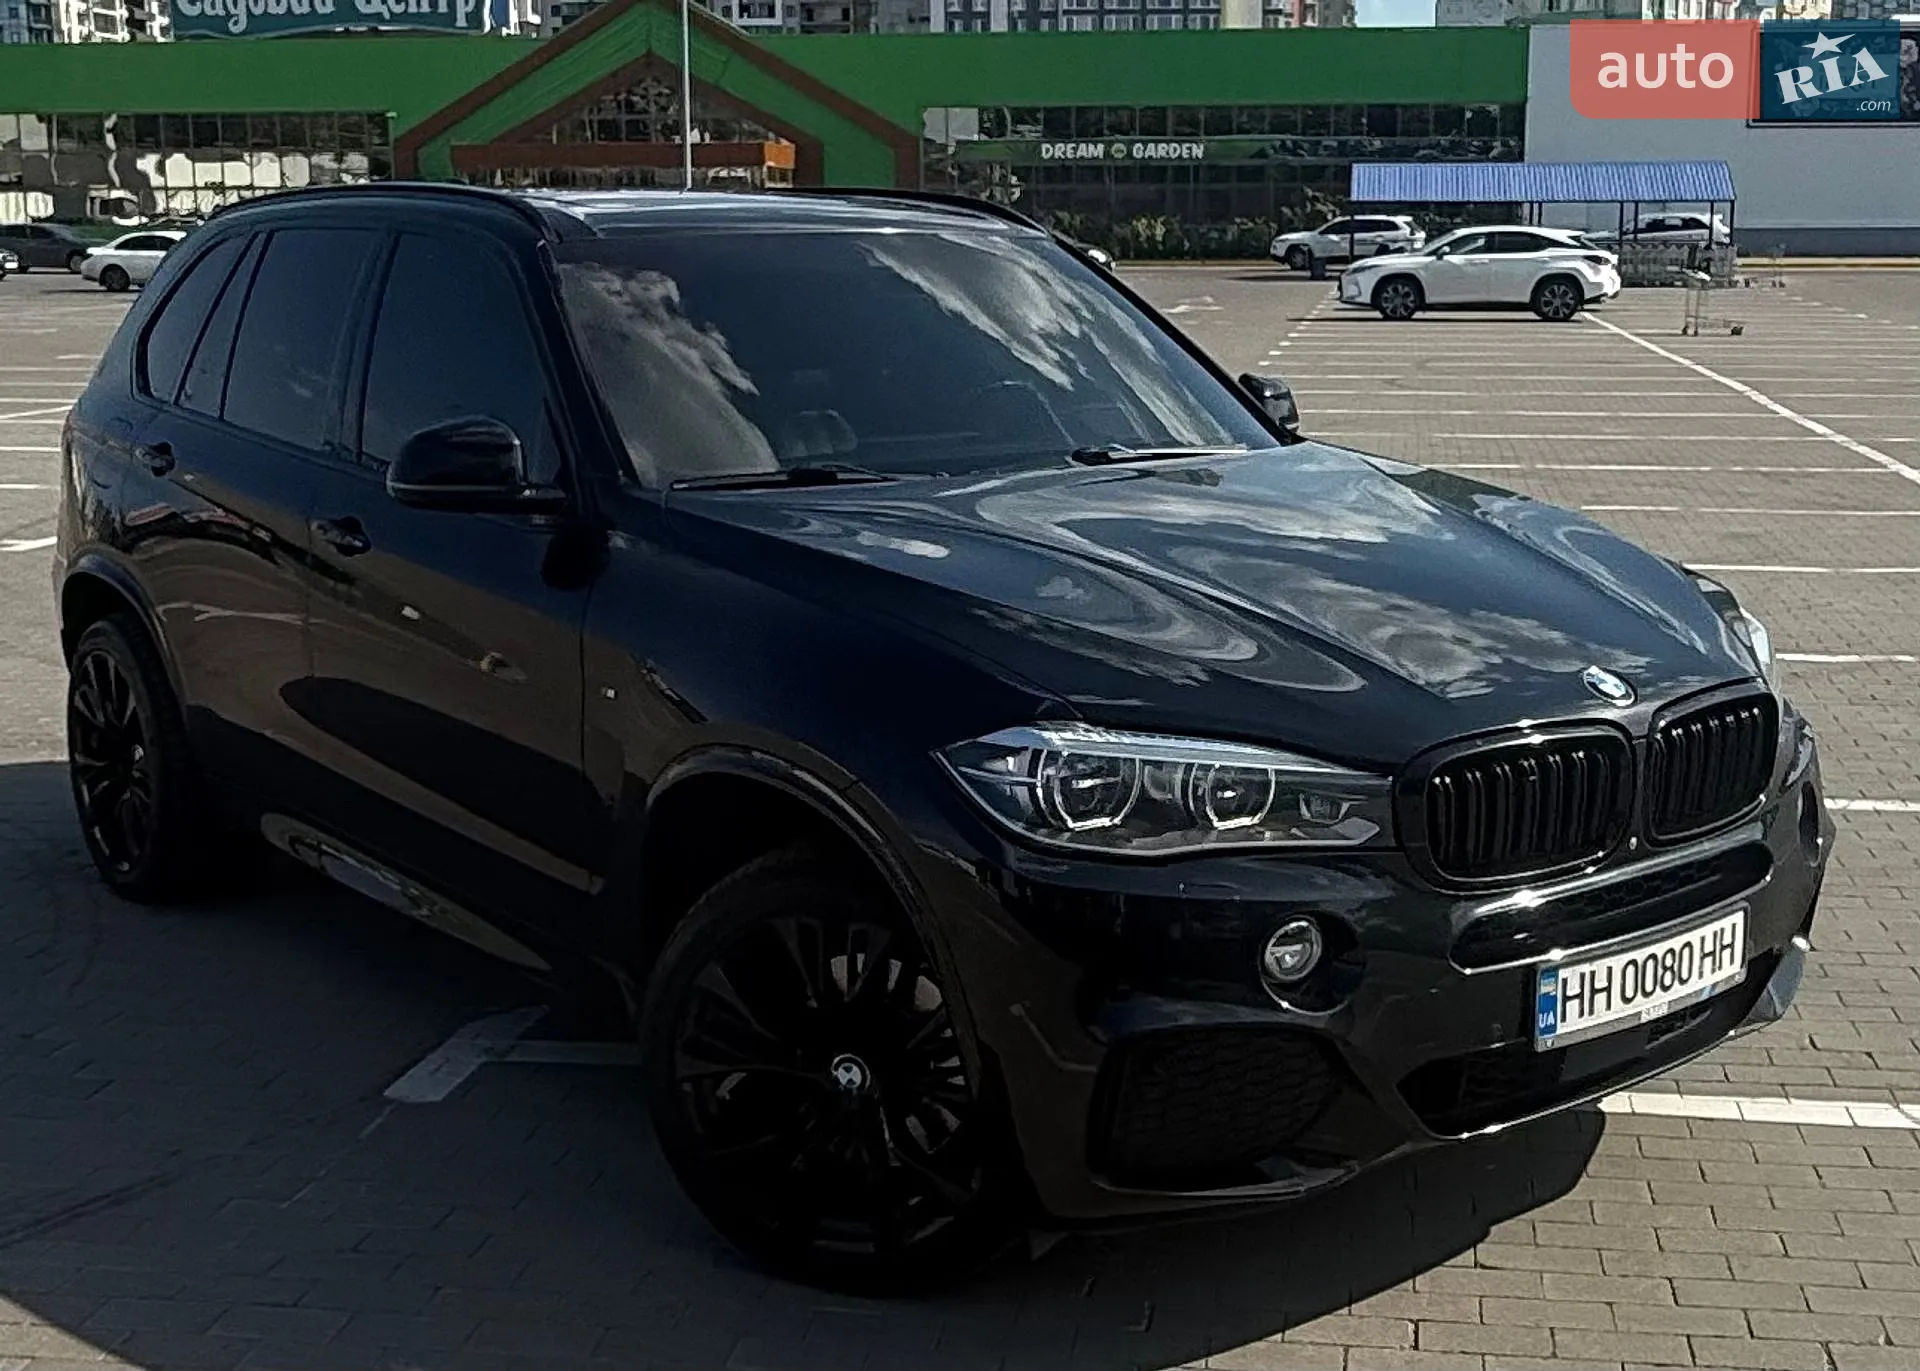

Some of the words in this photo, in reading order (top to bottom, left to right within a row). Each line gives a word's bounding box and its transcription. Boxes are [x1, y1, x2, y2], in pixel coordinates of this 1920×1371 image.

[1041, 143, 1105, 159] DREAM
[1132, 143, 1205, 159] GARDEN
[1620, 940, 1694, 1005] 0080
[1538, 1009, 1555, 1028] UA
